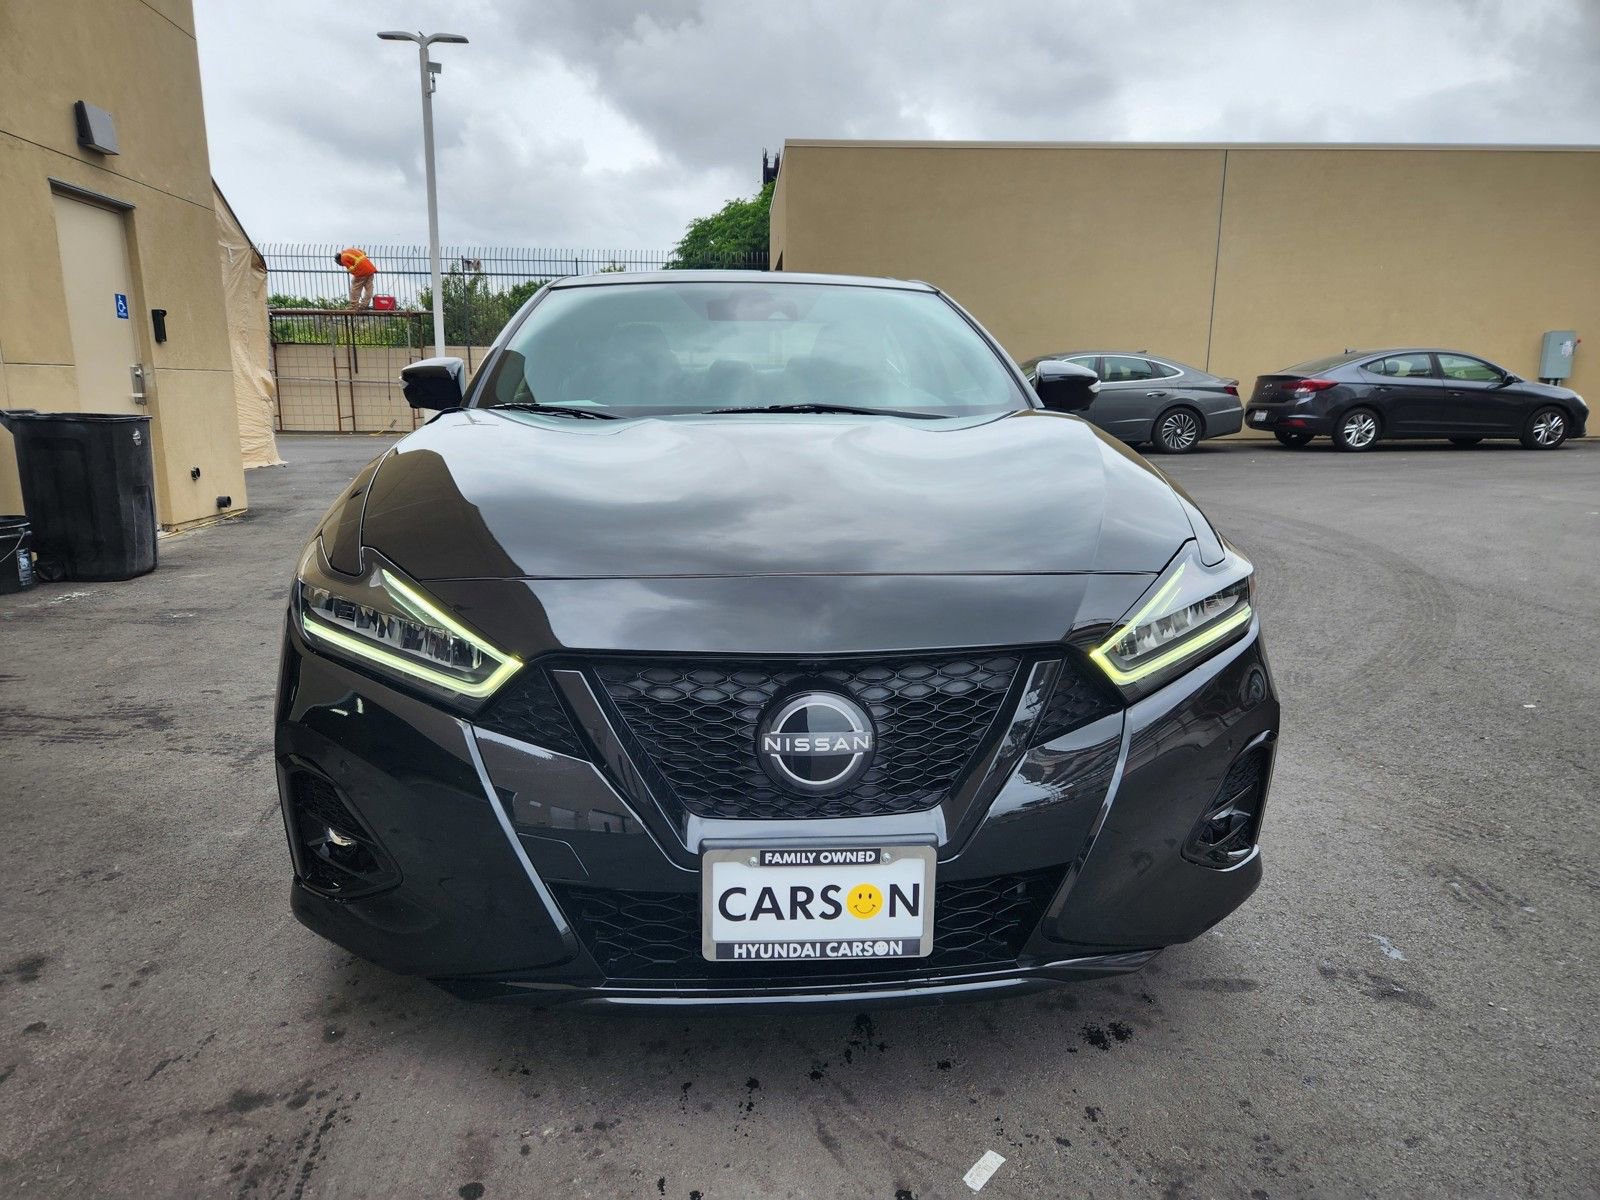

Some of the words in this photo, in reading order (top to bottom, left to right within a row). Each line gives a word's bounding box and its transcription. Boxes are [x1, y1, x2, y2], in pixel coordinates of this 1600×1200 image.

[764, 735, 869, 752] NISSAN
[764, 852, 816, 864] FAMILY
[820, 851, 876, 863] OWNED
[733, 943, 821, 959] HYUNDAI
[826, 940, 903, 957] CARSON
